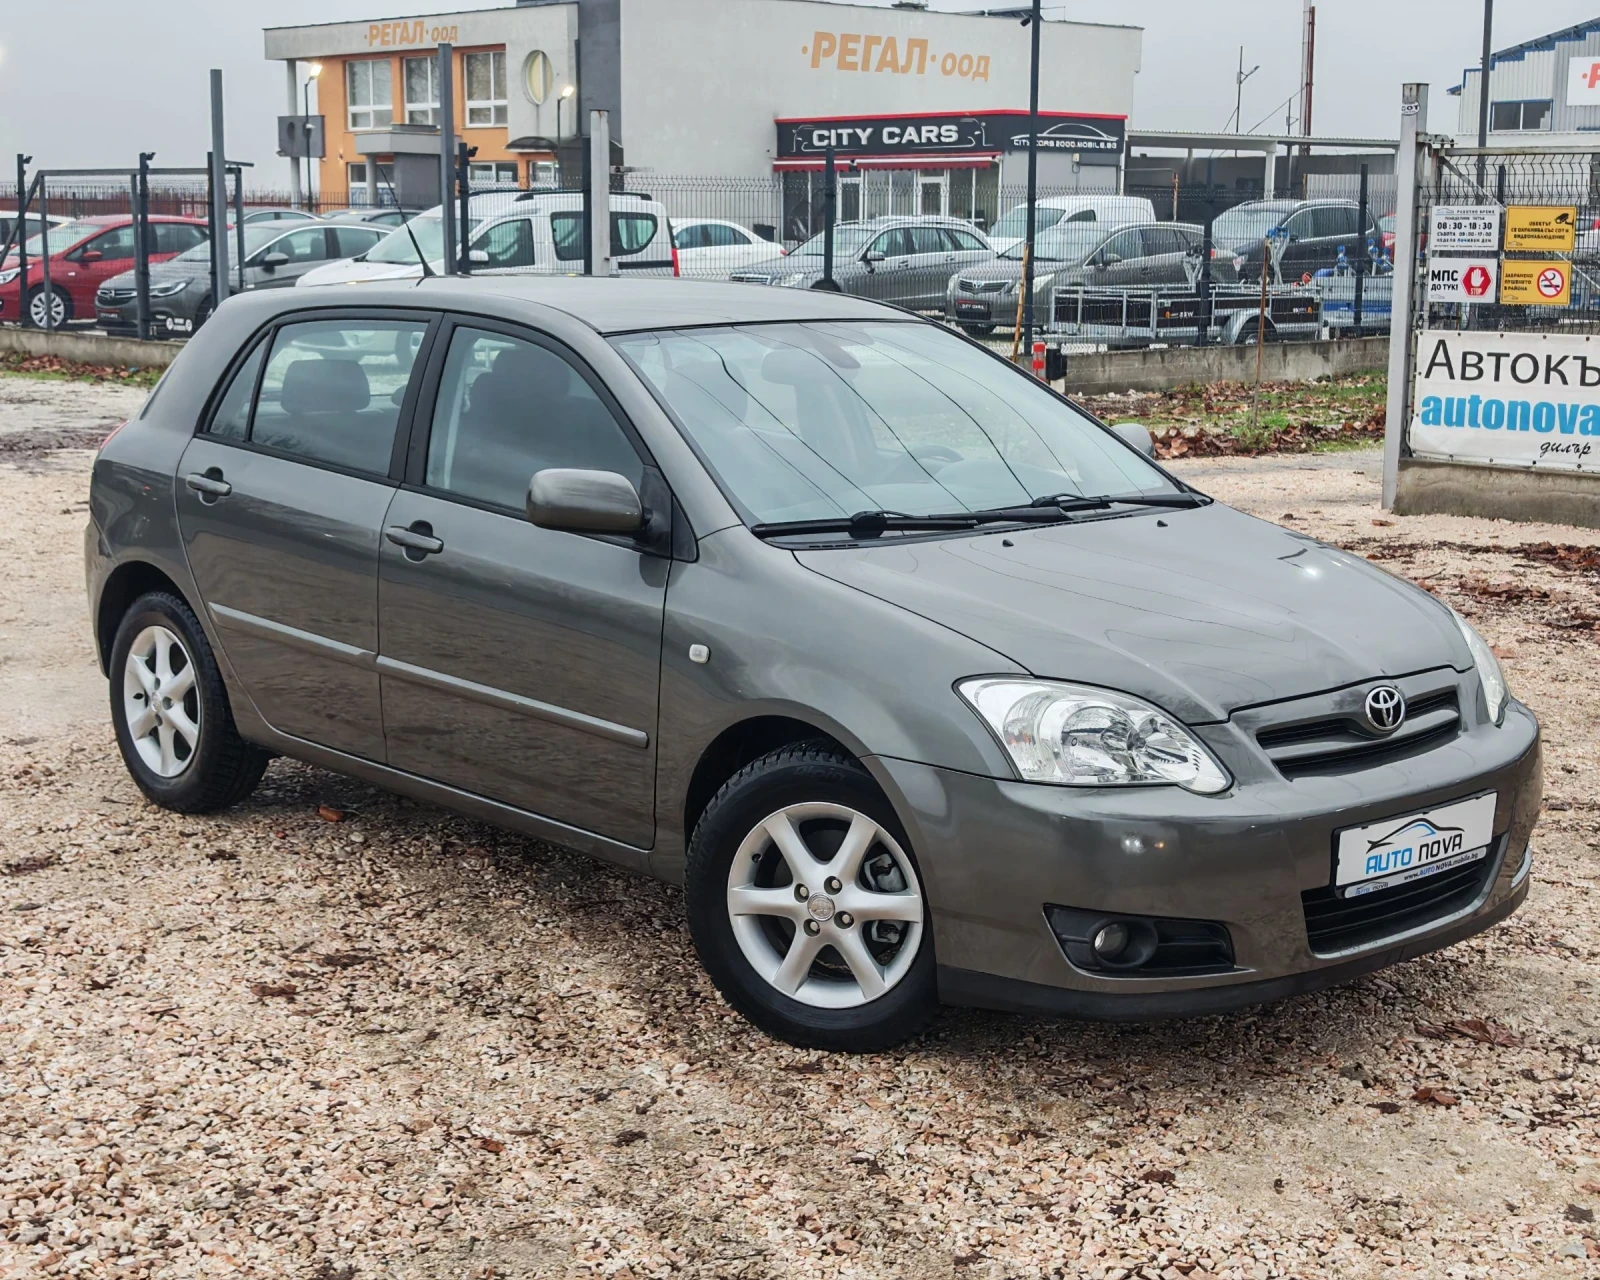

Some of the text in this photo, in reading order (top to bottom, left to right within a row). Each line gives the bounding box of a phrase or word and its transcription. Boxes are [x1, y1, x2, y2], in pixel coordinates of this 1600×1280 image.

[812, 125, 959, 147] CITY CARS
[1431, 269, 1459, 282] МПС
[1365, 833, 1463, 875] AUTO NOVA
